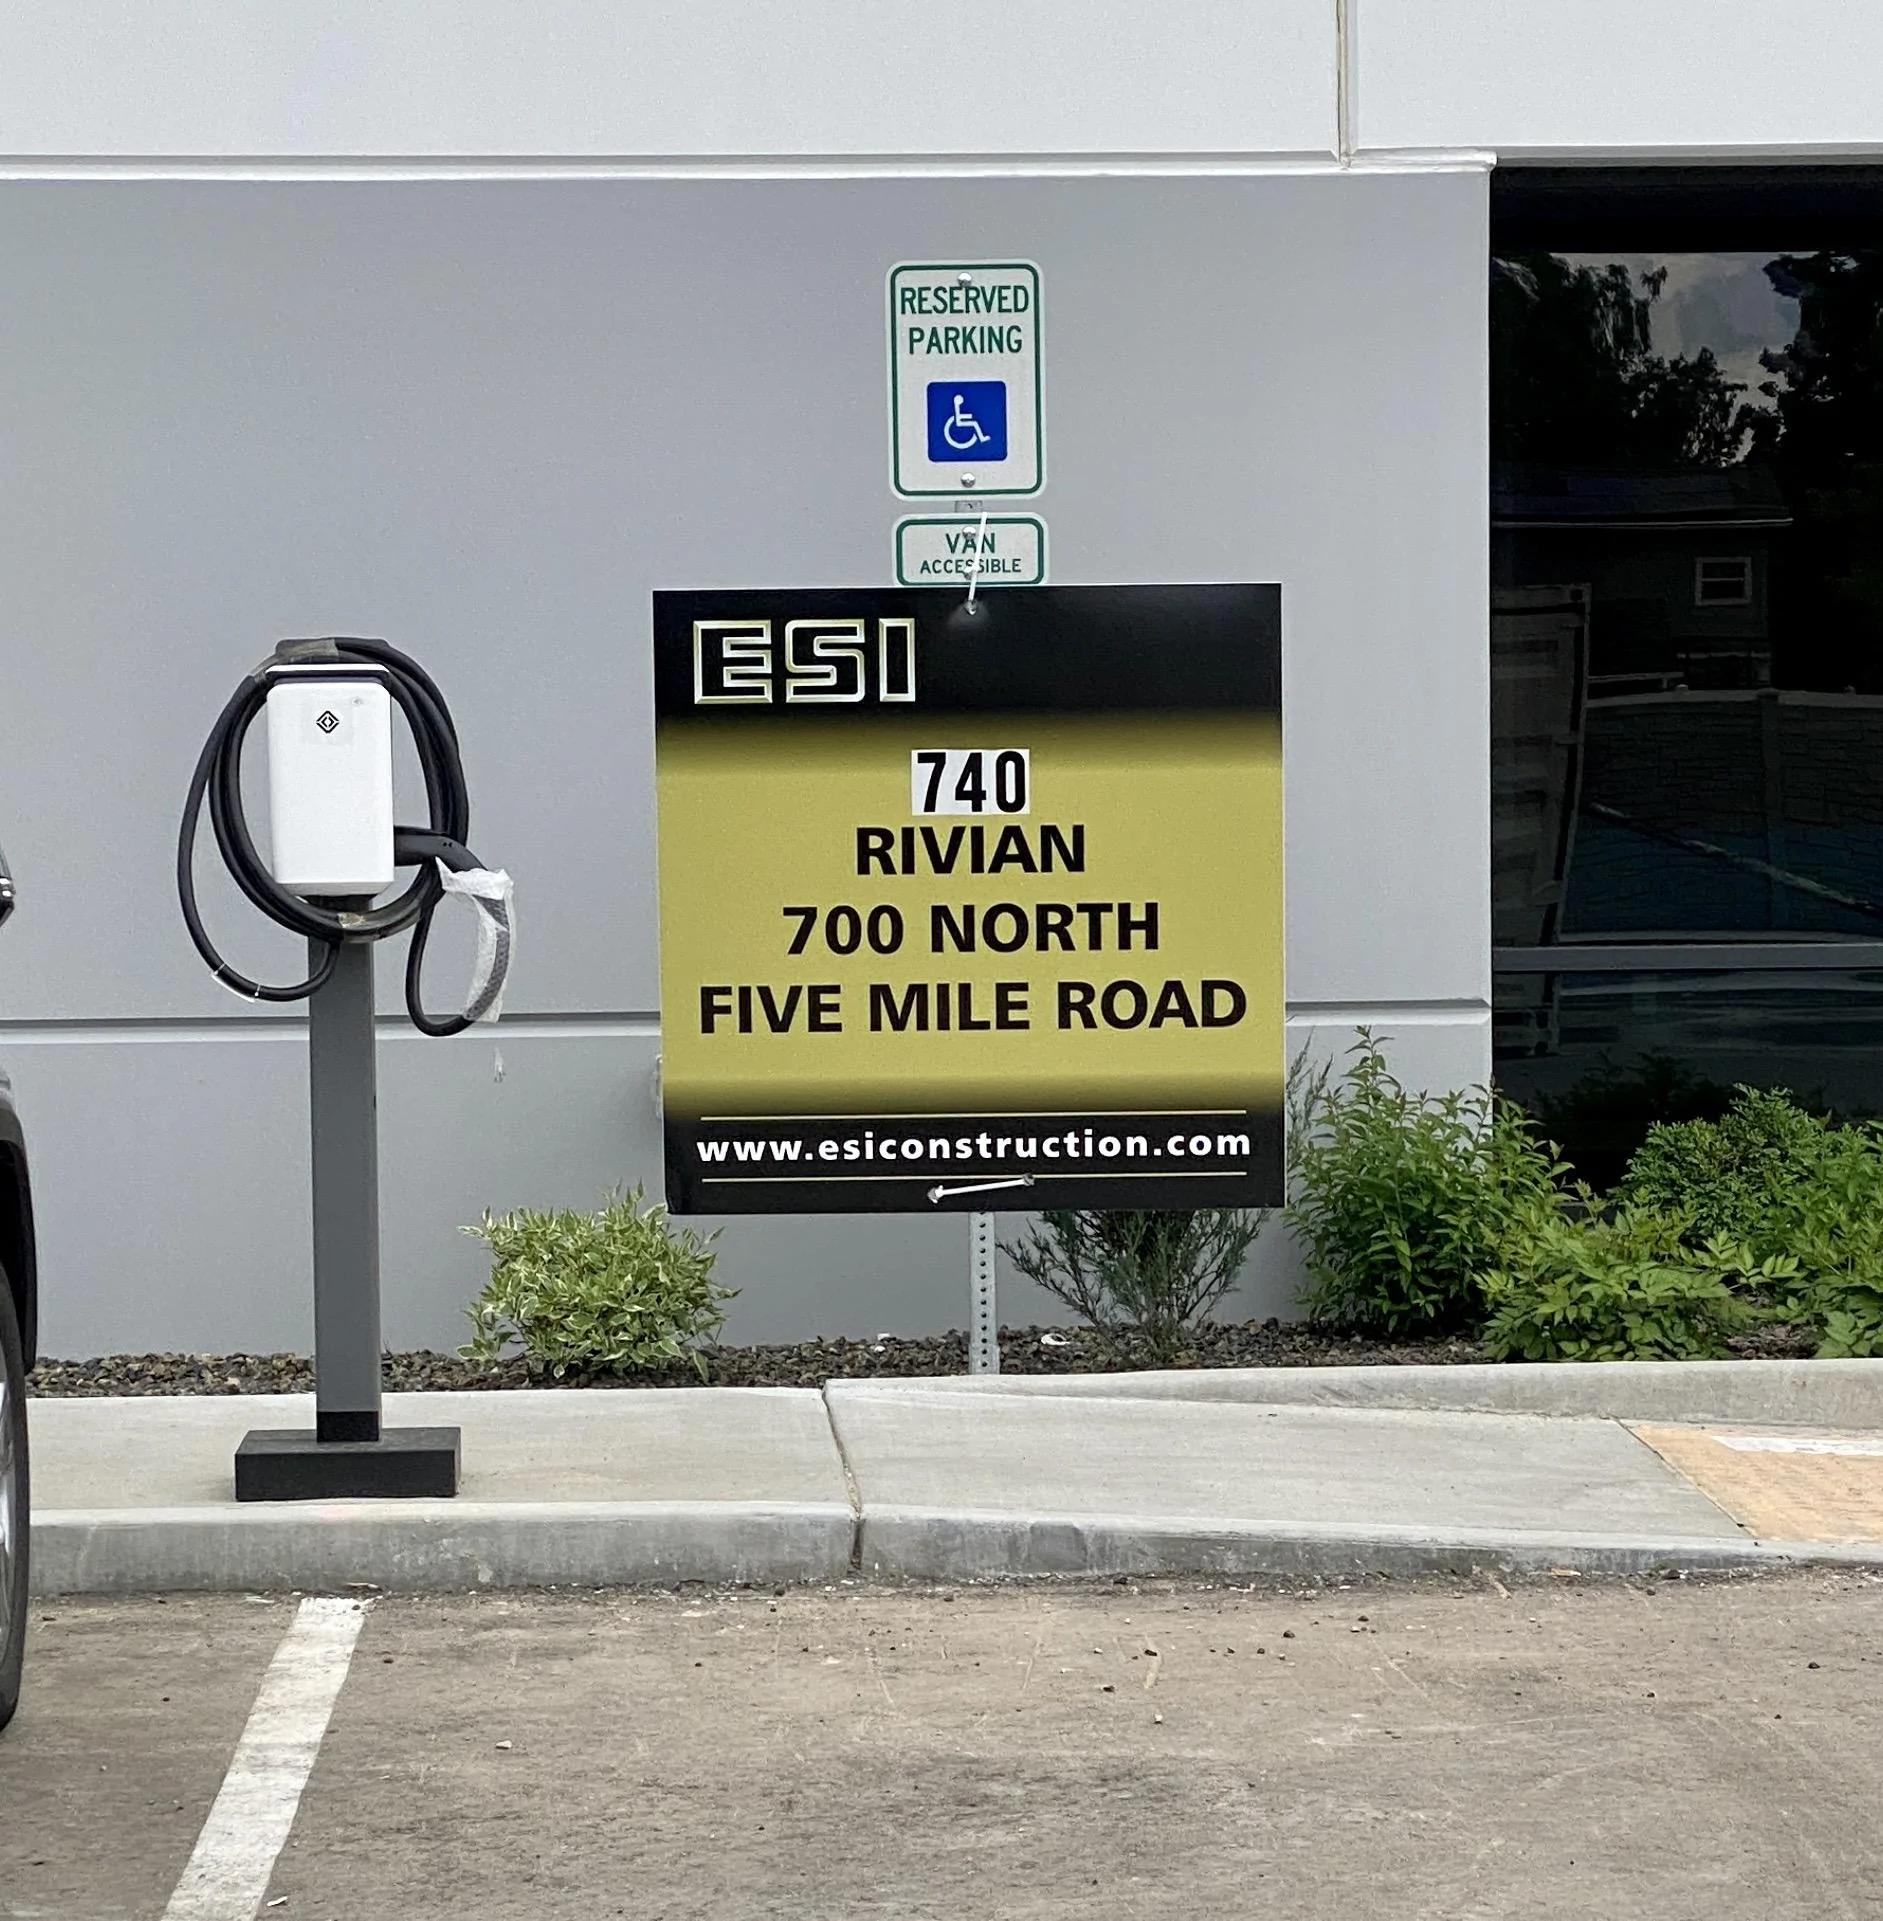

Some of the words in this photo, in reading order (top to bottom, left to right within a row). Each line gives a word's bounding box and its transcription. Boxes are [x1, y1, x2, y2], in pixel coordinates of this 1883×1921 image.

[900, 285, 1029, 315] RESERVED
[908, 326, 1023, 354] PARKING
[945, 533, 996, 554] VAN
[693, 618, 916, 705] ESI
[916, 751, 1026, 813] 740
[856, 824, 1085, 876] RIVIAN
[782, 904, 904, 956] 700
[930, 902, 1159, 953] NORTH
[701, 984, 843, 1035] FIVE
[869, 982, 1030, 1032] MILE
[1056, 980, 1247, 1030] ROAD
[697, 1129, 1251, 1163] www.esiconstruction.com
